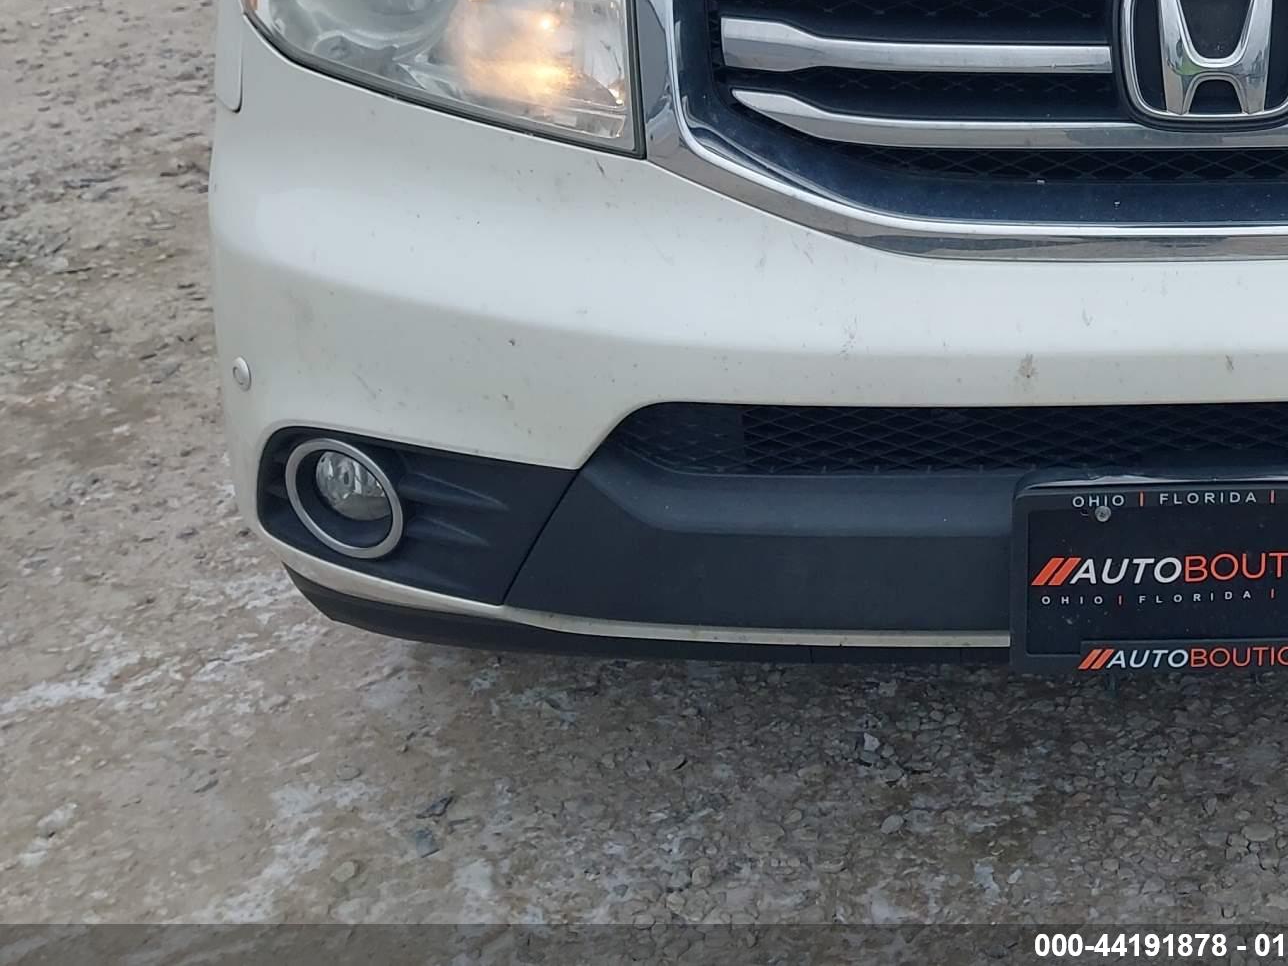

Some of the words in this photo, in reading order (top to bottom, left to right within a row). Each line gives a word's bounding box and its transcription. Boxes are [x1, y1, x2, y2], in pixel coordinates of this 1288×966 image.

[1072, 494, 1125, 509] OHIO
[1158, 491, 1258, 505] FLORIDA
[1040, 595, 1104, 605] OHIO
[1138, 590, 1252, 604] FLORIDA
